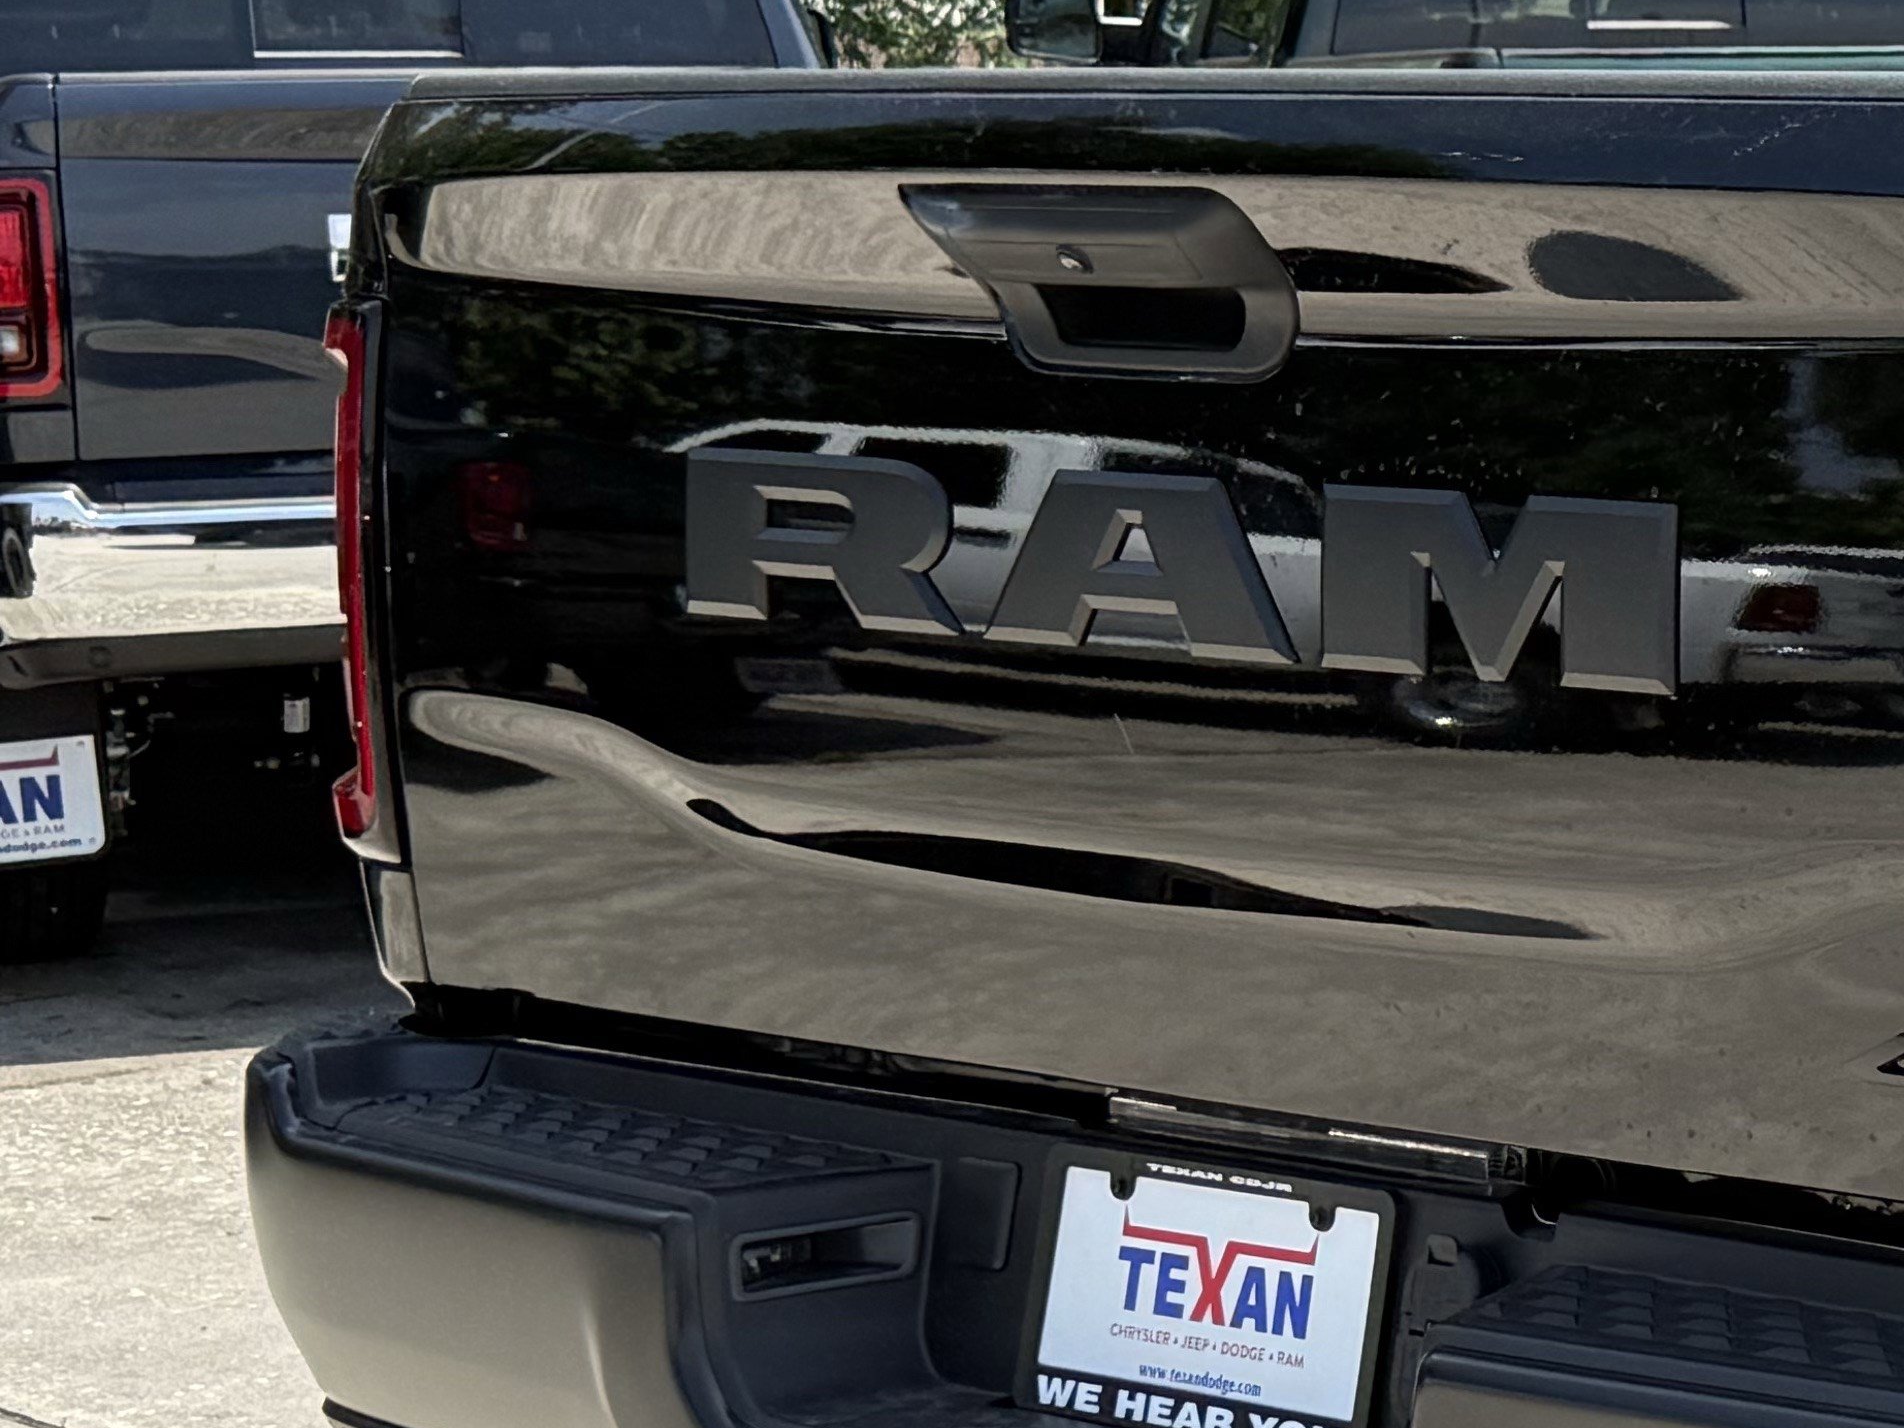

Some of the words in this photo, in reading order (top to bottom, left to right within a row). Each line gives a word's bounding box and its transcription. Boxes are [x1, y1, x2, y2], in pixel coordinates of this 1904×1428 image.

[684, 447, 1679, 696] RAM
[1147, 1162, 1223, 1182] TEXAN
[1118, 1203, 1319, 1339] TEXAN
[1109, 1323, 1171, 1346] CHRYSLER
[1180, 1335, 1210, 1352] JEEP
[1220, 1341, 1266, 1362] DODGE
[1276, 1351, 1305, 1369] RAM
[1037, 1373, 1103, 1415] WE
